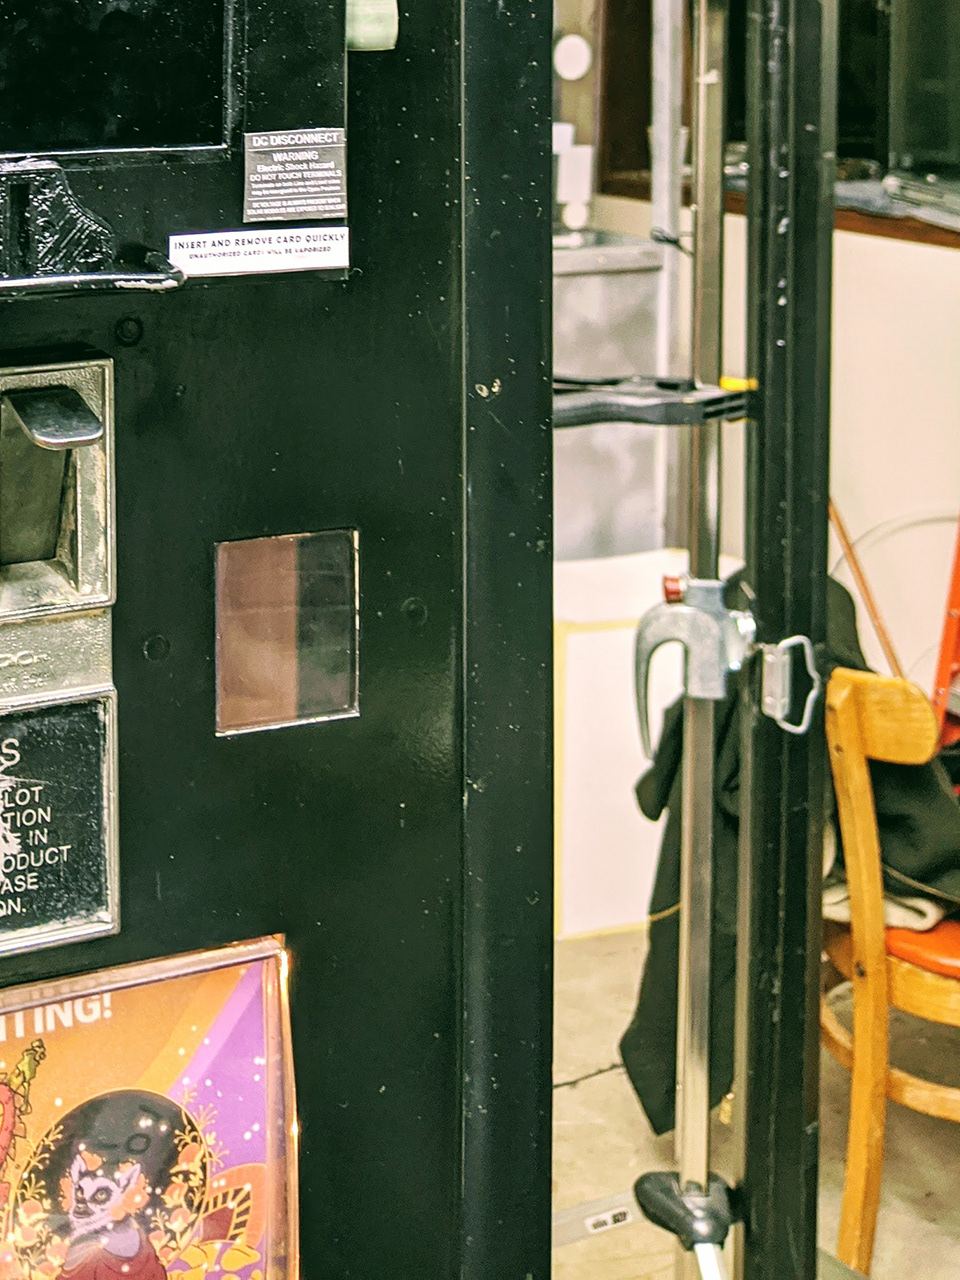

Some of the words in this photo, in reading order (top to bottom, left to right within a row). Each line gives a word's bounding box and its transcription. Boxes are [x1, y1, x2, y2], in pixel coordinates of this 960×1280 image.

[252, 136, 268, 146] DC
[270, 132, 339, 146] DISCONNECT
[272, 151, 318, 162] WARNING
[256, 164, 284, 172] Electric
[285, 162, 308, 170] Shock
[278, 172, 302, 180] TOUCH
[302, 170, 342, 178] TERMINALS
[174, 240, 206, 250] INSERT
[211, 239, 230, 248] AND
[234, 237, 272, 246] REMOVE
[276, 235, 302, 244] CARD
[305, 234, 345, 243] QUICKLY
[189, 251, 241, 259] UNAUTHORIZED
[4, 786, 43, 808] LOT
[2, 845, 72, 873] ODUCT
